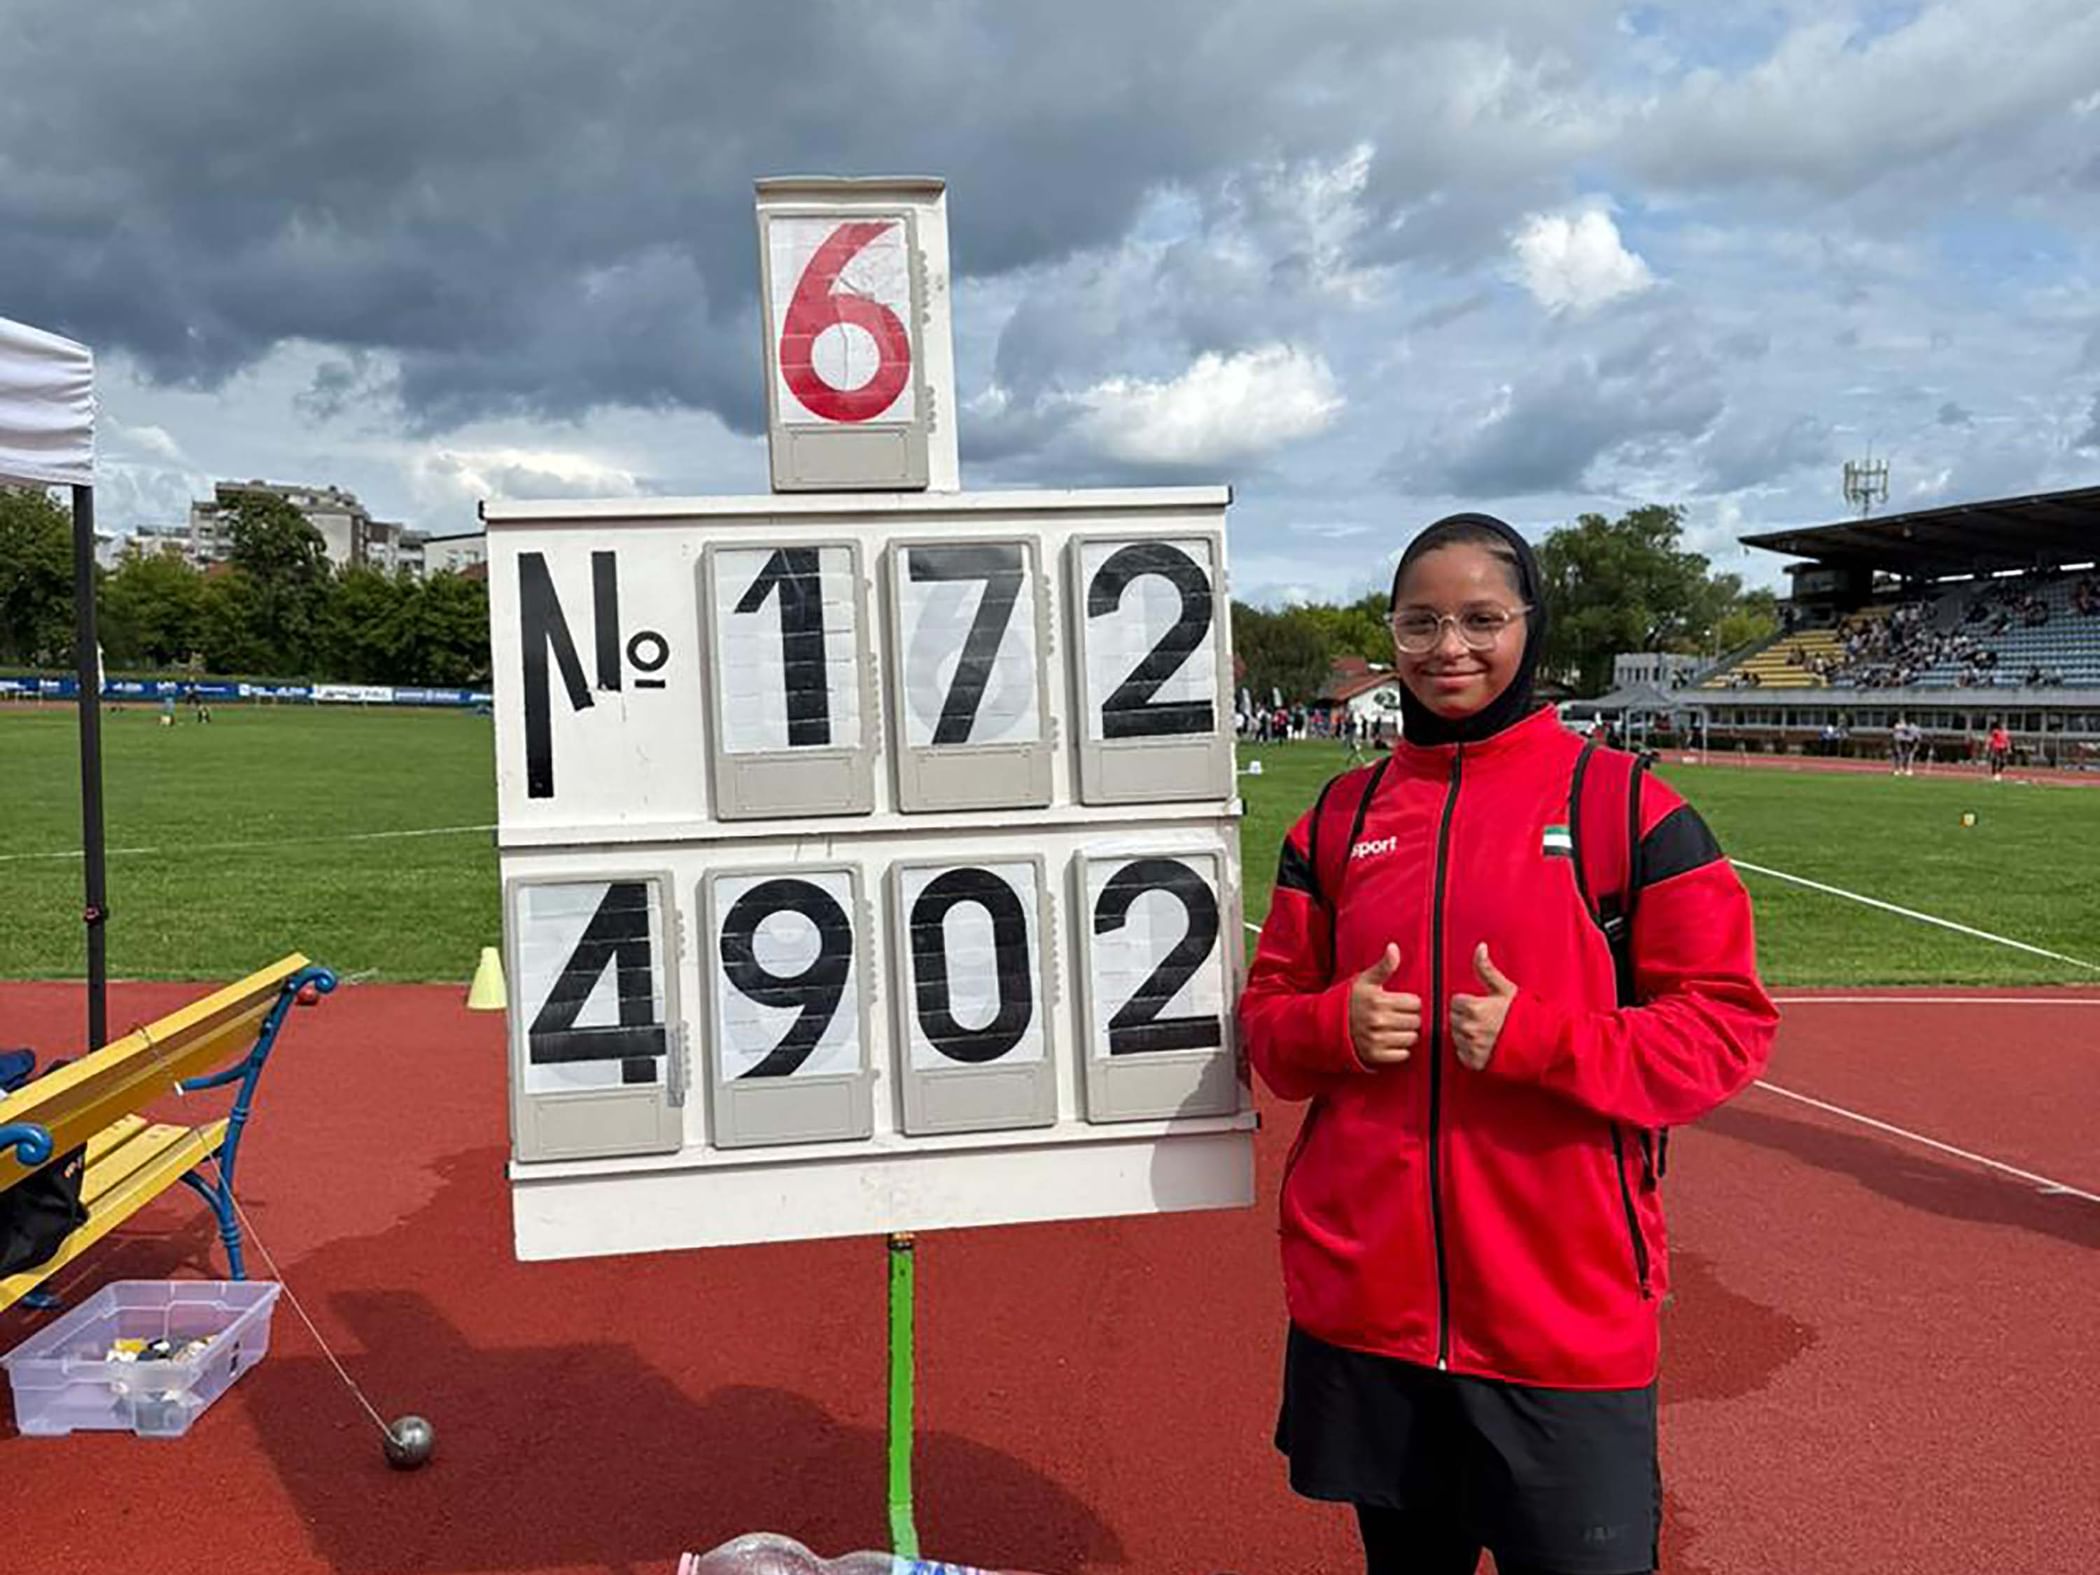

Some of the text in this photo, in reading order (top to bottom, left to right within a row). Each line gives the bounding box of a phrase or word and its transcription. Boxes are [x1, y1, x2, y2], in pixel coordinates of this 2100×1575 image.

[779, 221, 911, 424] 6
[733, 541, 1216, 746] 172
[528, 859, 1221, 1084] 4902
